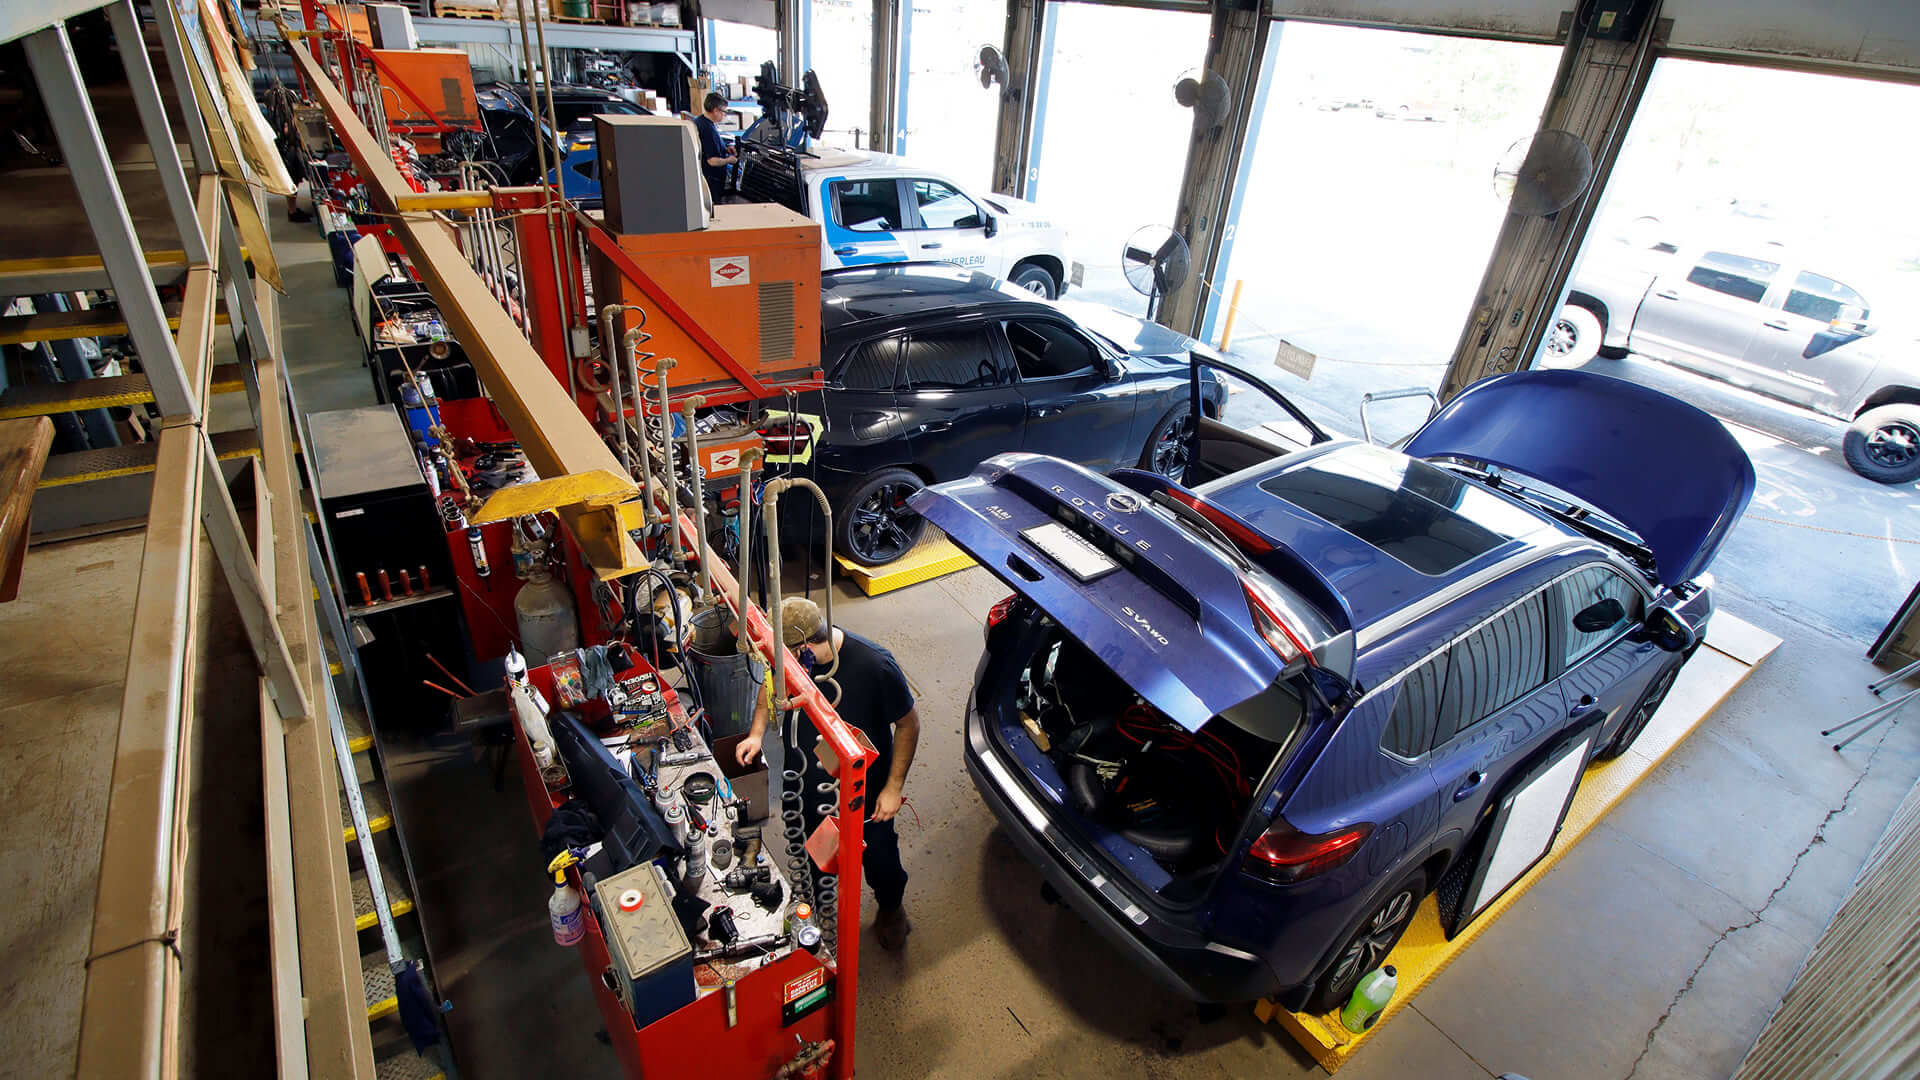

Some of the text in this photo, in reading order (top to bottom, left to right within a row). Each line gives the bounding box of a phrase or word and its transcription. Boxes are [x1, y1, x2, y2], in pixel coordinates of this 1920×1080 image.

[1030, 167, 1038, 181] 3
[1225, 224, 1235, 240] 2
[1051, 485, 1152, 551] ROGUE
